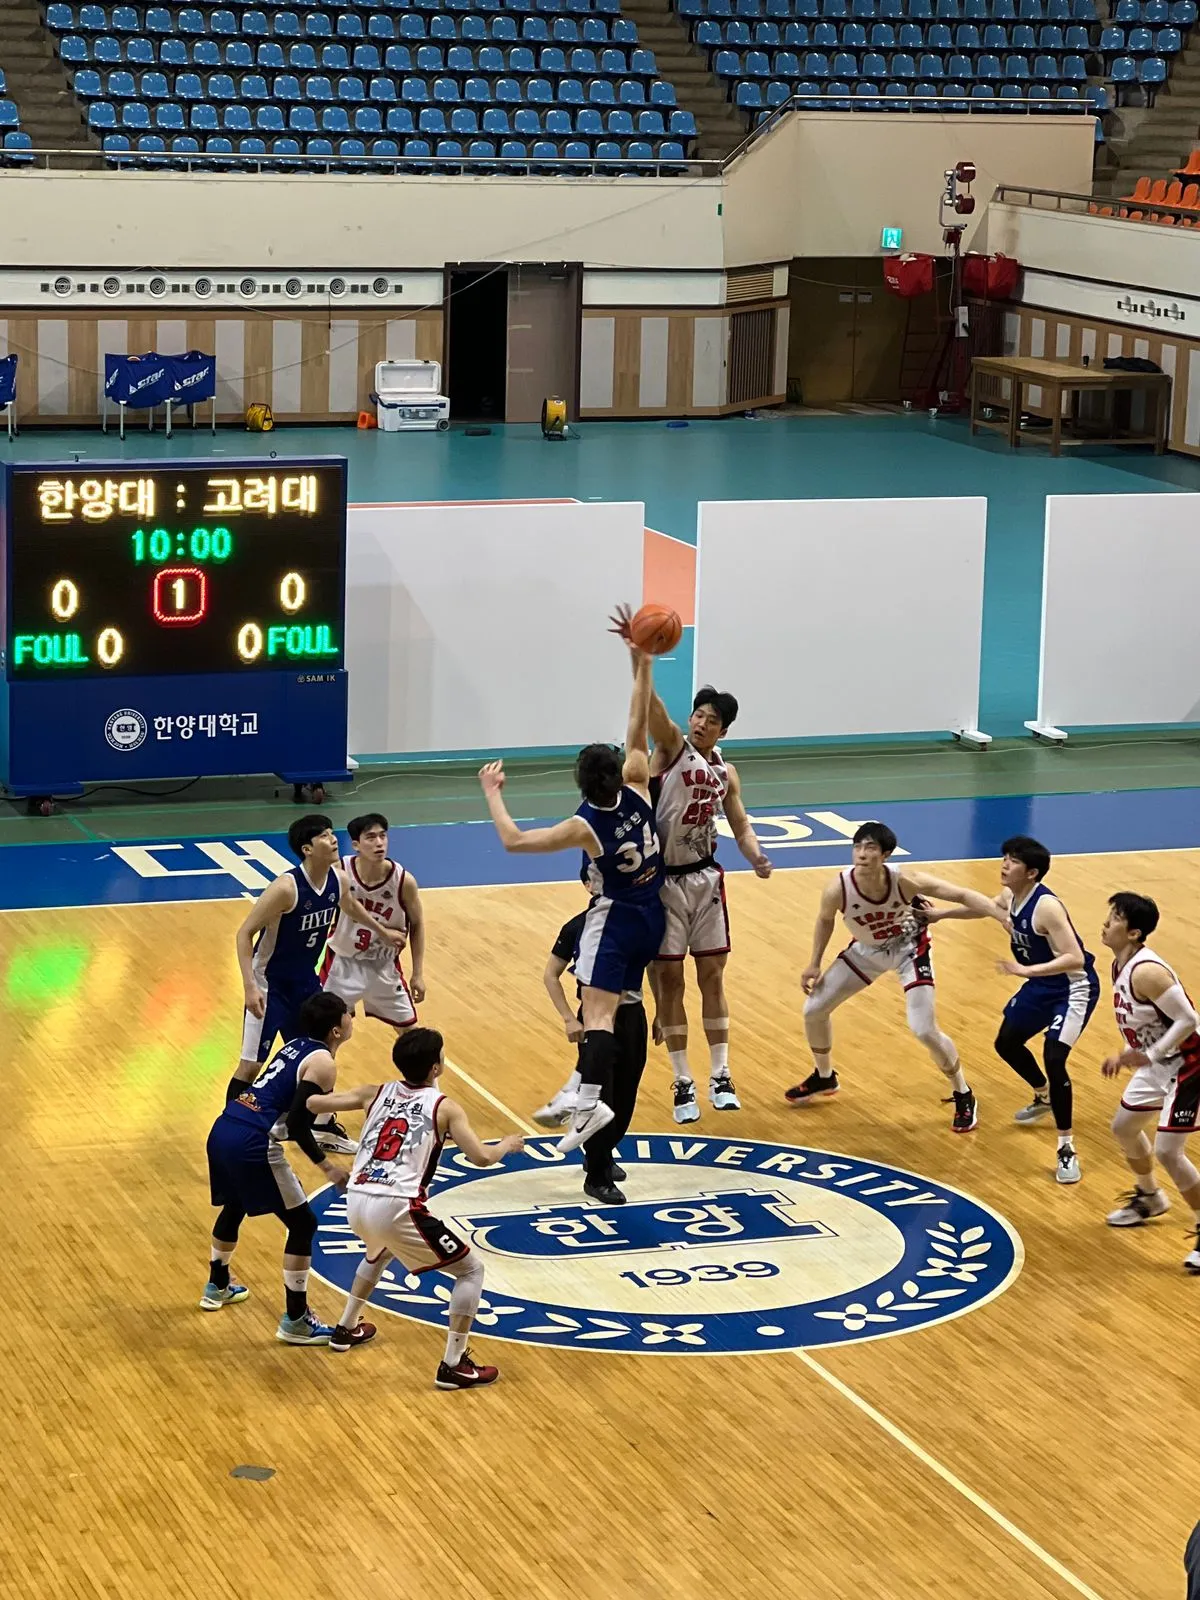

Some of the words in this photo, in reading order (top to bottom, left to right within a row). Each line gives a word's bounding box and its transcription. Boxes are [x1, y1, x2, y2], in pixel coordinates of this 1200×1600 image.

[38, 478, 155, 520] 한양대
[203, 475, 318, 514] 고려대
[132, 527, 233, 561] 10:00
[52, 579, 79, 618] 0
[171, 578, 186, 611] 1
[279, 572, 306, 610] 0
[14, 634, 90, 665] FOUL
[97, 627, 124, 665] 0
[237, 623, 263, 660] 0
[267, 625, 339, 656] FOUL
[306, 674, 324, 683] SAM
[153, 712, 259, 740] 한양대학교
[614, 820, 660, 873] 34
[298, 907, 335, 932] HYU
[306, 932, 320, 948] 5
[354, 928, 372, 952] 3
[1050, 1014, 1063, 1030] 2
[372, 1116, 410, 1162] 6
[529, 1204, 748, 1249] 한양
[438, 1234, 458, 1254] 6
[619, 1260, 781, 1290] 1939
